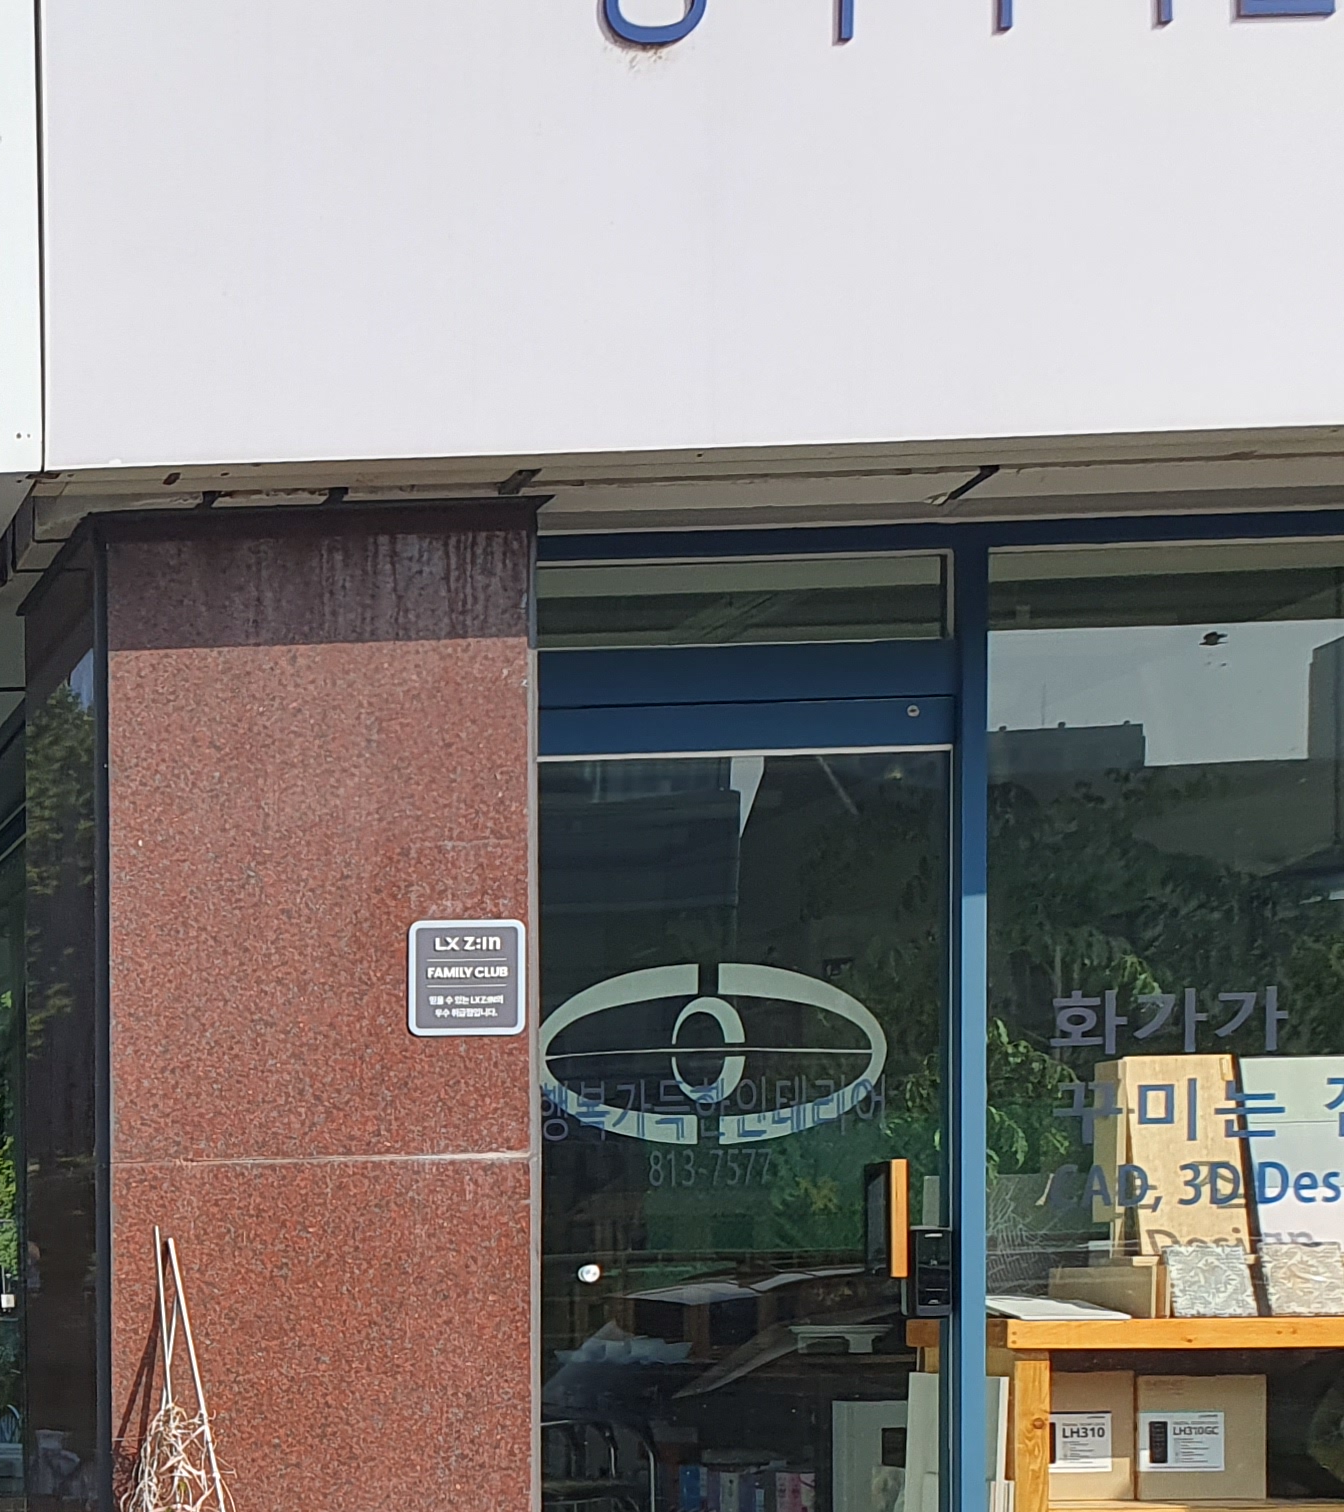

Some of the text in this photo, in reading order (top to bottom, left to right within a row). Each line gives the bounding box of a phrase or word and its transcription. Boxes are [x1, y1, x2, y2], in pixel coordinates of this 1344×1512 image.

[434, 936, 460, 951] LX
[427, 966, 509, 979] FAMILY CLUB
[445, 995, 454, 1005] 수
[1049, 985, 1289, 1056] 화가가
[1053, 1077, 1286, 1145] 꾸미는
[649, 1149, 773, 1188] 813-7577
[1050, 1162, 1163, 1213] CAD,
[1178, 1162, 1241, 1206] 3D
[1062, 1427, 1106, 1438] LH310
